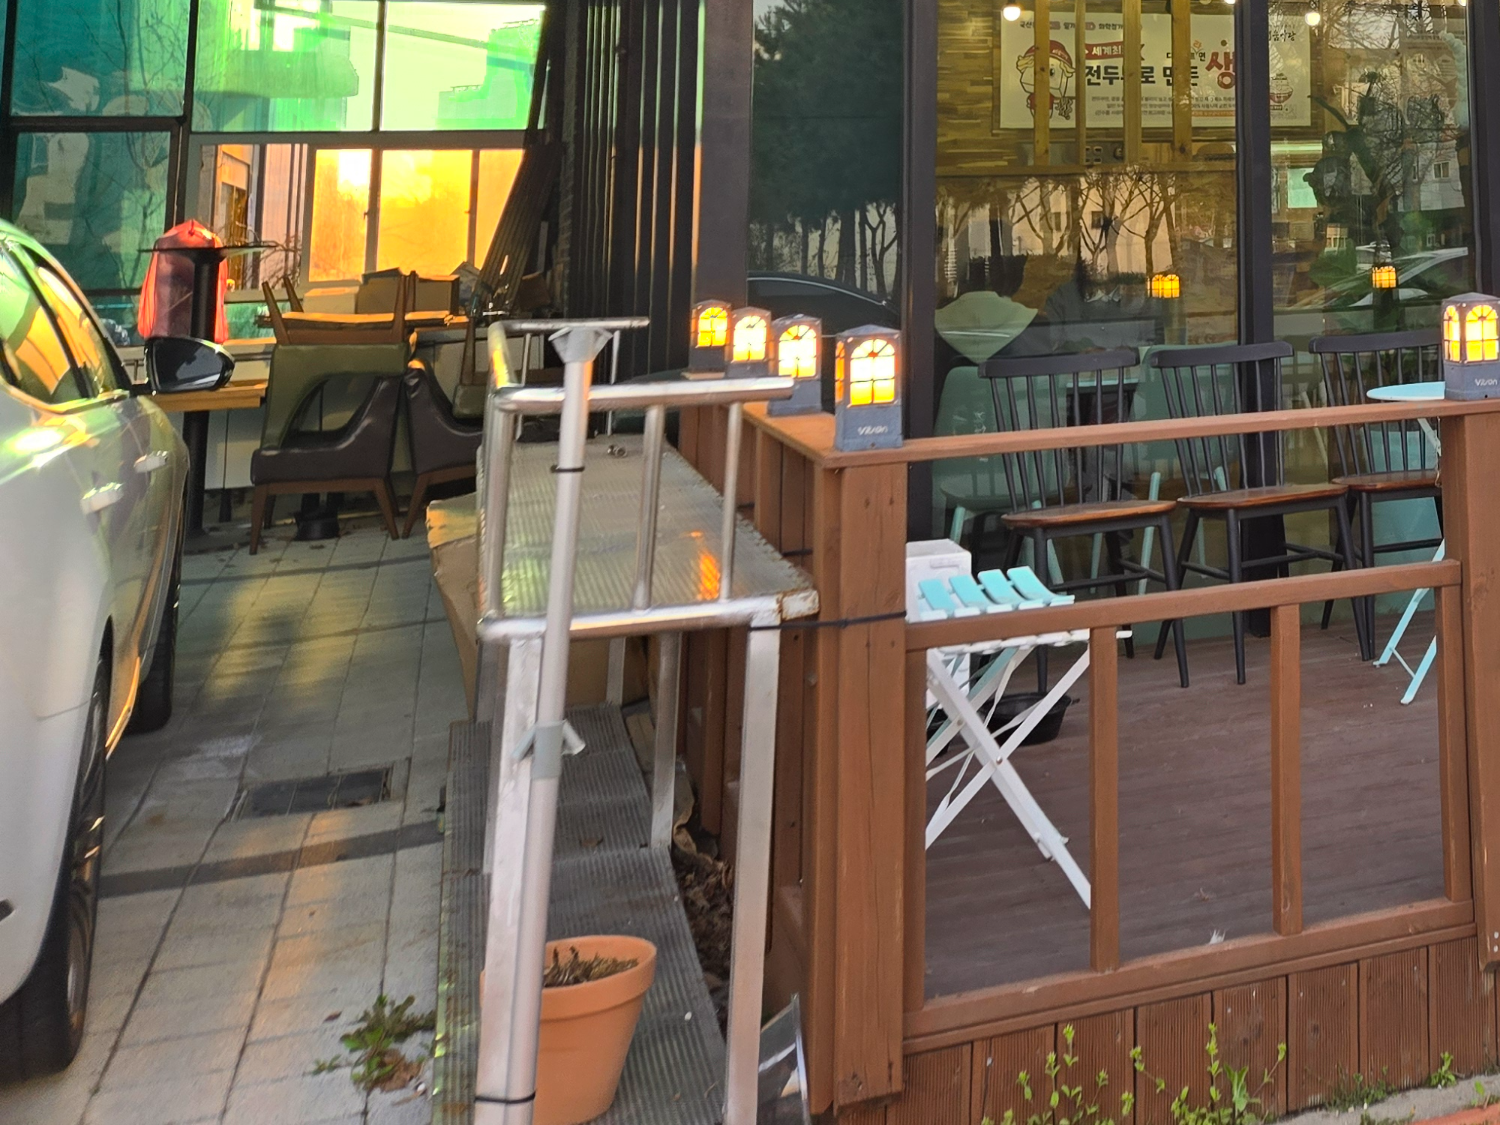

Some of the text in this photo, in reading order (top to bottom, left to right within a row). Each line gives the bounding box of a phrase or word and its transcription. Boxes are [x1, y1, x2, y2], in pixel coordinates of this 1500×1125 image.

[1092, 44, 1124, 57] 세계최
[1085, 65, 1155, 87] 전두로
[1205, 51, 1235, 89] 생
